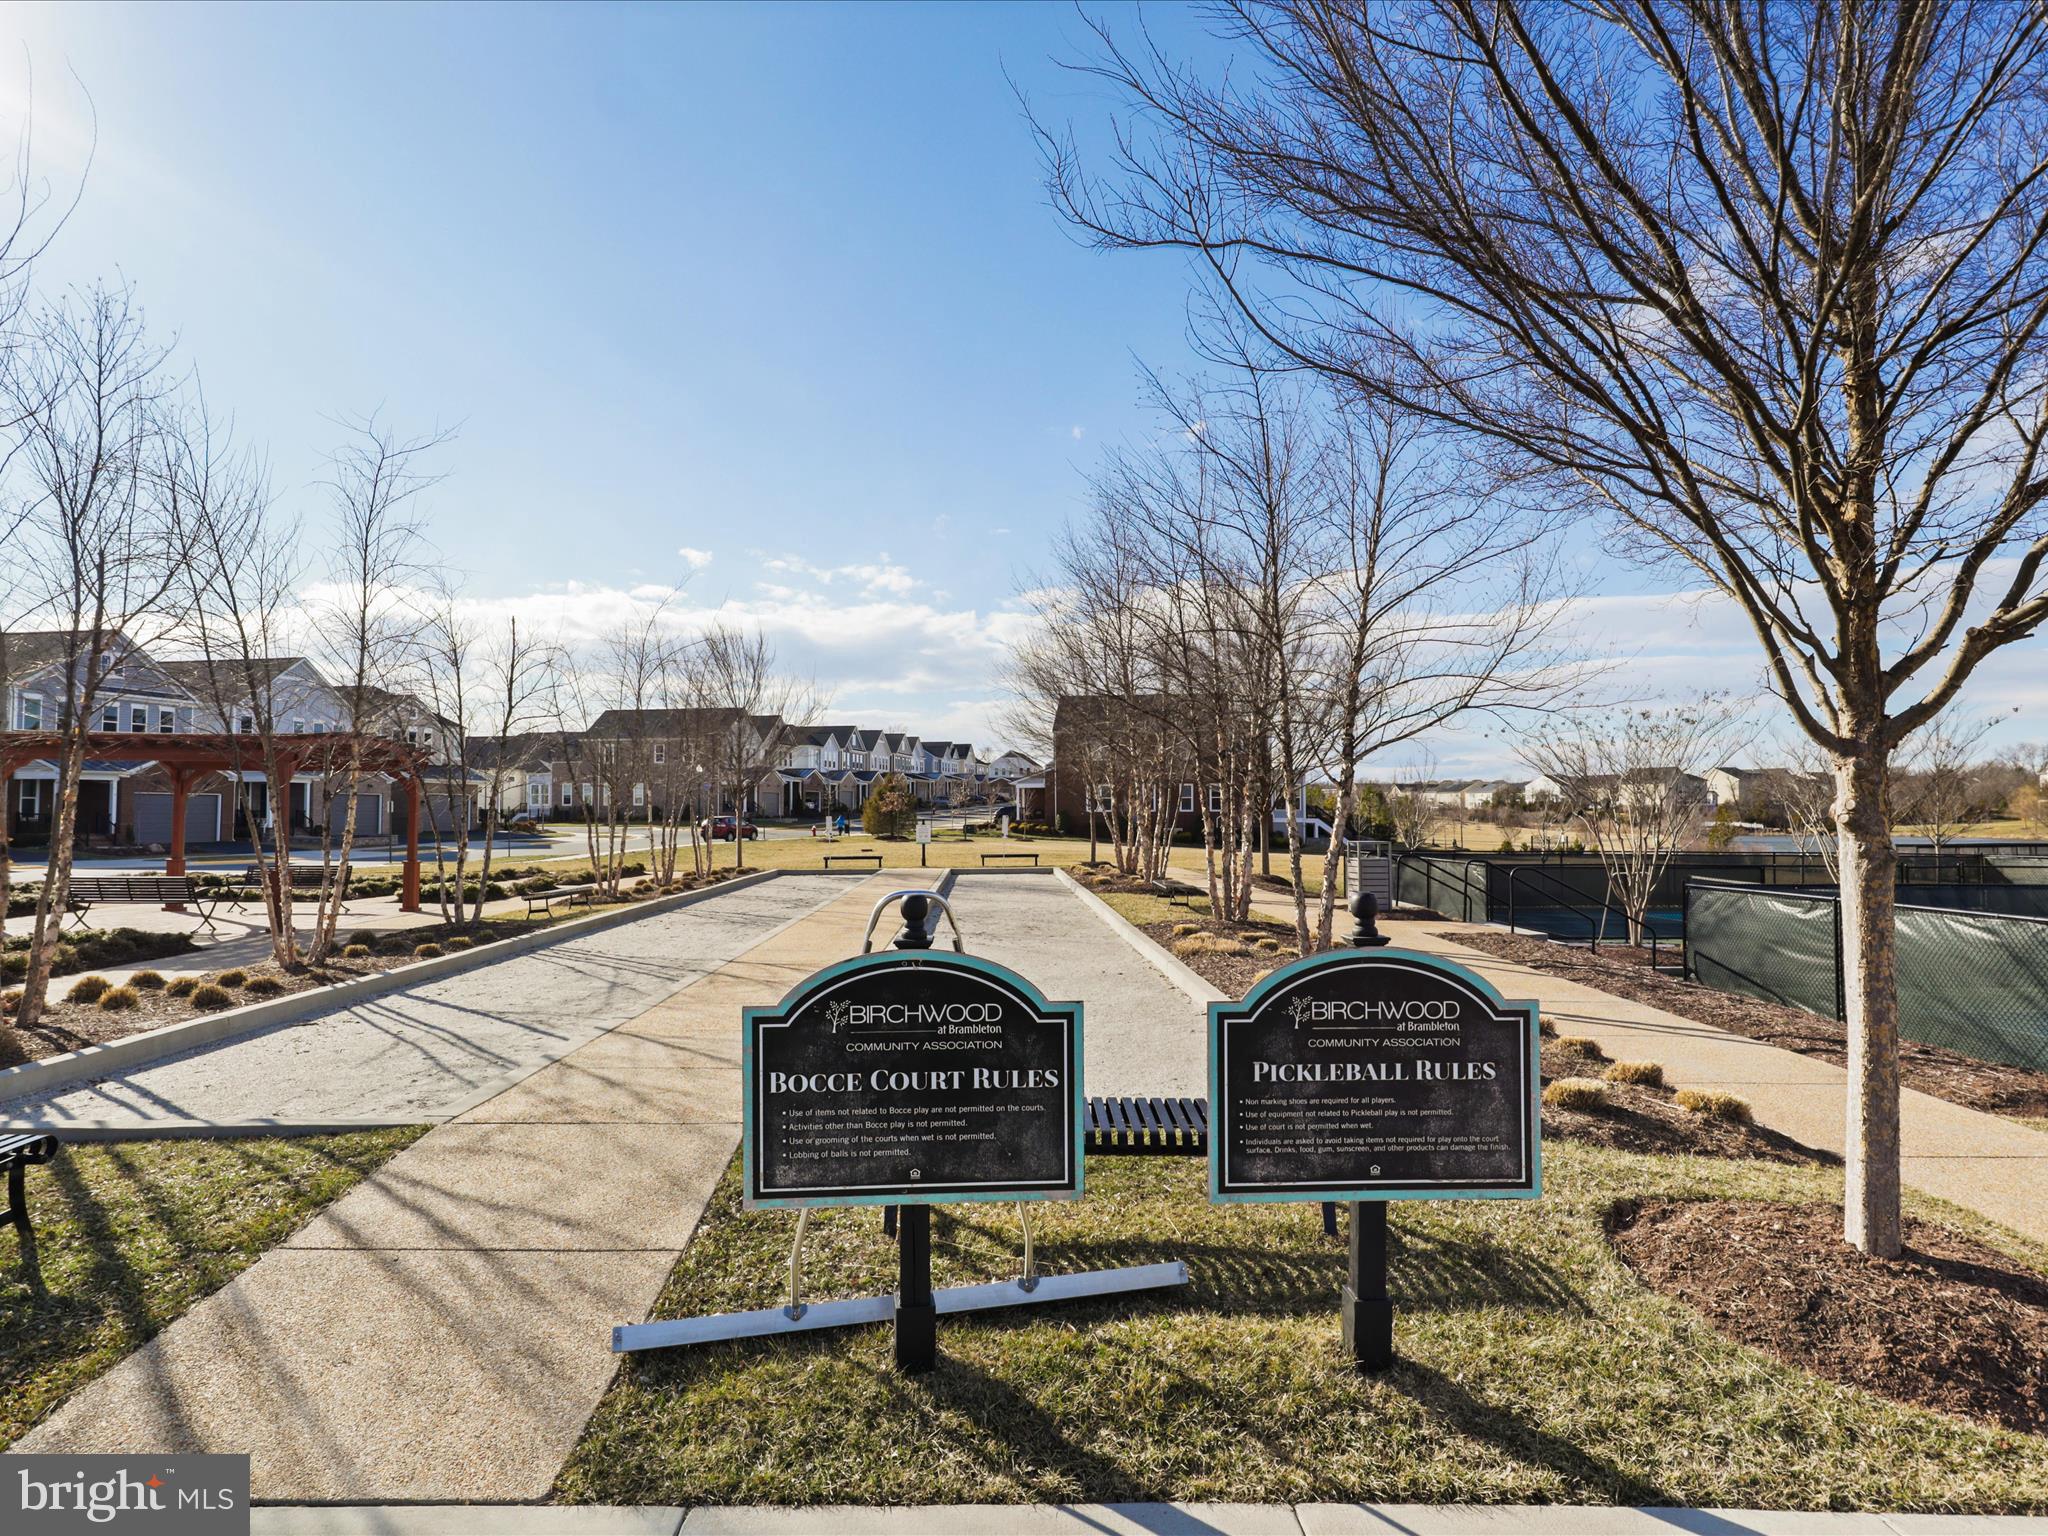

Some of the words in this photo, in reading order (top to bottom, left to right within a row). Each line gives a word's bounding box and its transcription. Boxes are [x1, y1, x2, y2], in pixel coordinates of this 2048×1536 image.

[850, 1003, 1002, 1024] BIRCHWOOD
[1311, 1000, 1460, 1020] BIRCHWOOD
[938, 1026, 947, 1034] at
[949, 1024, 1002, 1035] Brambleton
[1396, 1022, 1406, 1031] at
[1408, 1021, 1459, 1032] Brambleton
[846, 1041, 920, 1052] COMMUNITY
[923, 1040, 1002, 1050] ASSOCIATION
[1308, 1038, 1380, 1048] COMMUNITY
[1383, 1038, 1460, 1047] ASSOCIATION
[1261, 1098, 1287, 1106] marking
[1321, 1097, 1348, 1105] required
[914, 1106, 929, 1114] play
[959, 1105, 994, 1114] permitted
[1268, 1111, 1304, 1119] equipment
[1385, 1109, 1398, 1117] play
[789, 1122, 823, 1130] Activities
[825, 1122, 844, 1130] other
[890, 1121, 906, 1129] play
[930, 1119, 968, 1128] permitted.
[1307, 1122, 1340, 1131] permitted
[815, 1137, 849, 1145] grooming
[959, 1132, 997, 1141] permitted.
[1344, 1136, 1364, 1144] taking
[1398, 1135, 1425, 1144] required
[789, 1151, 819, 1159] Lobbing
[821, 1150, 828, 1158] of
[873, 1149, 911, 1158] permitted.
[1246, 1146, 1272, 1154] surface.
[1300, 1145, 1316, 1153] food,
[1318, 1146, 1334, 1154] gum,
[1406, 1144, 1435, 1152] products
[1450, 1143, 1476, 1151] damage
